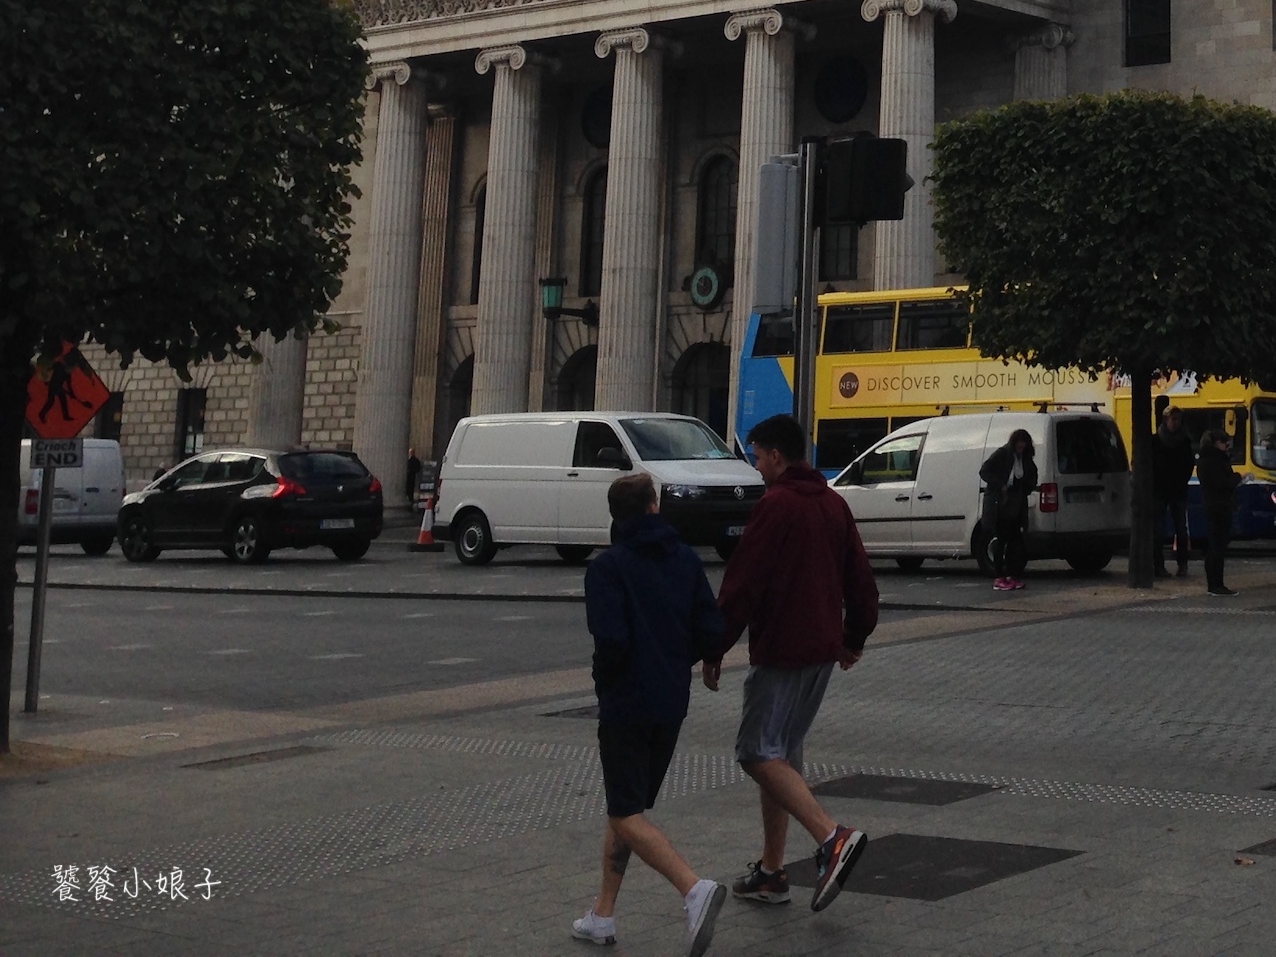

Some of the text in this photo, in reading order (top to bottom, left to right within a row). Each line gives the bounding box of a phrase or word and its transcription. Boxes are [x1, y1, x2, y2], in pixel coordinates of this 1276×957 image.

[839, 381, 858, 390] NEW
[867, 375, 941, 391] DISCOVER
[952, 373, 1017, 389] SMOOTH
[35, 453, 77, 465] END
